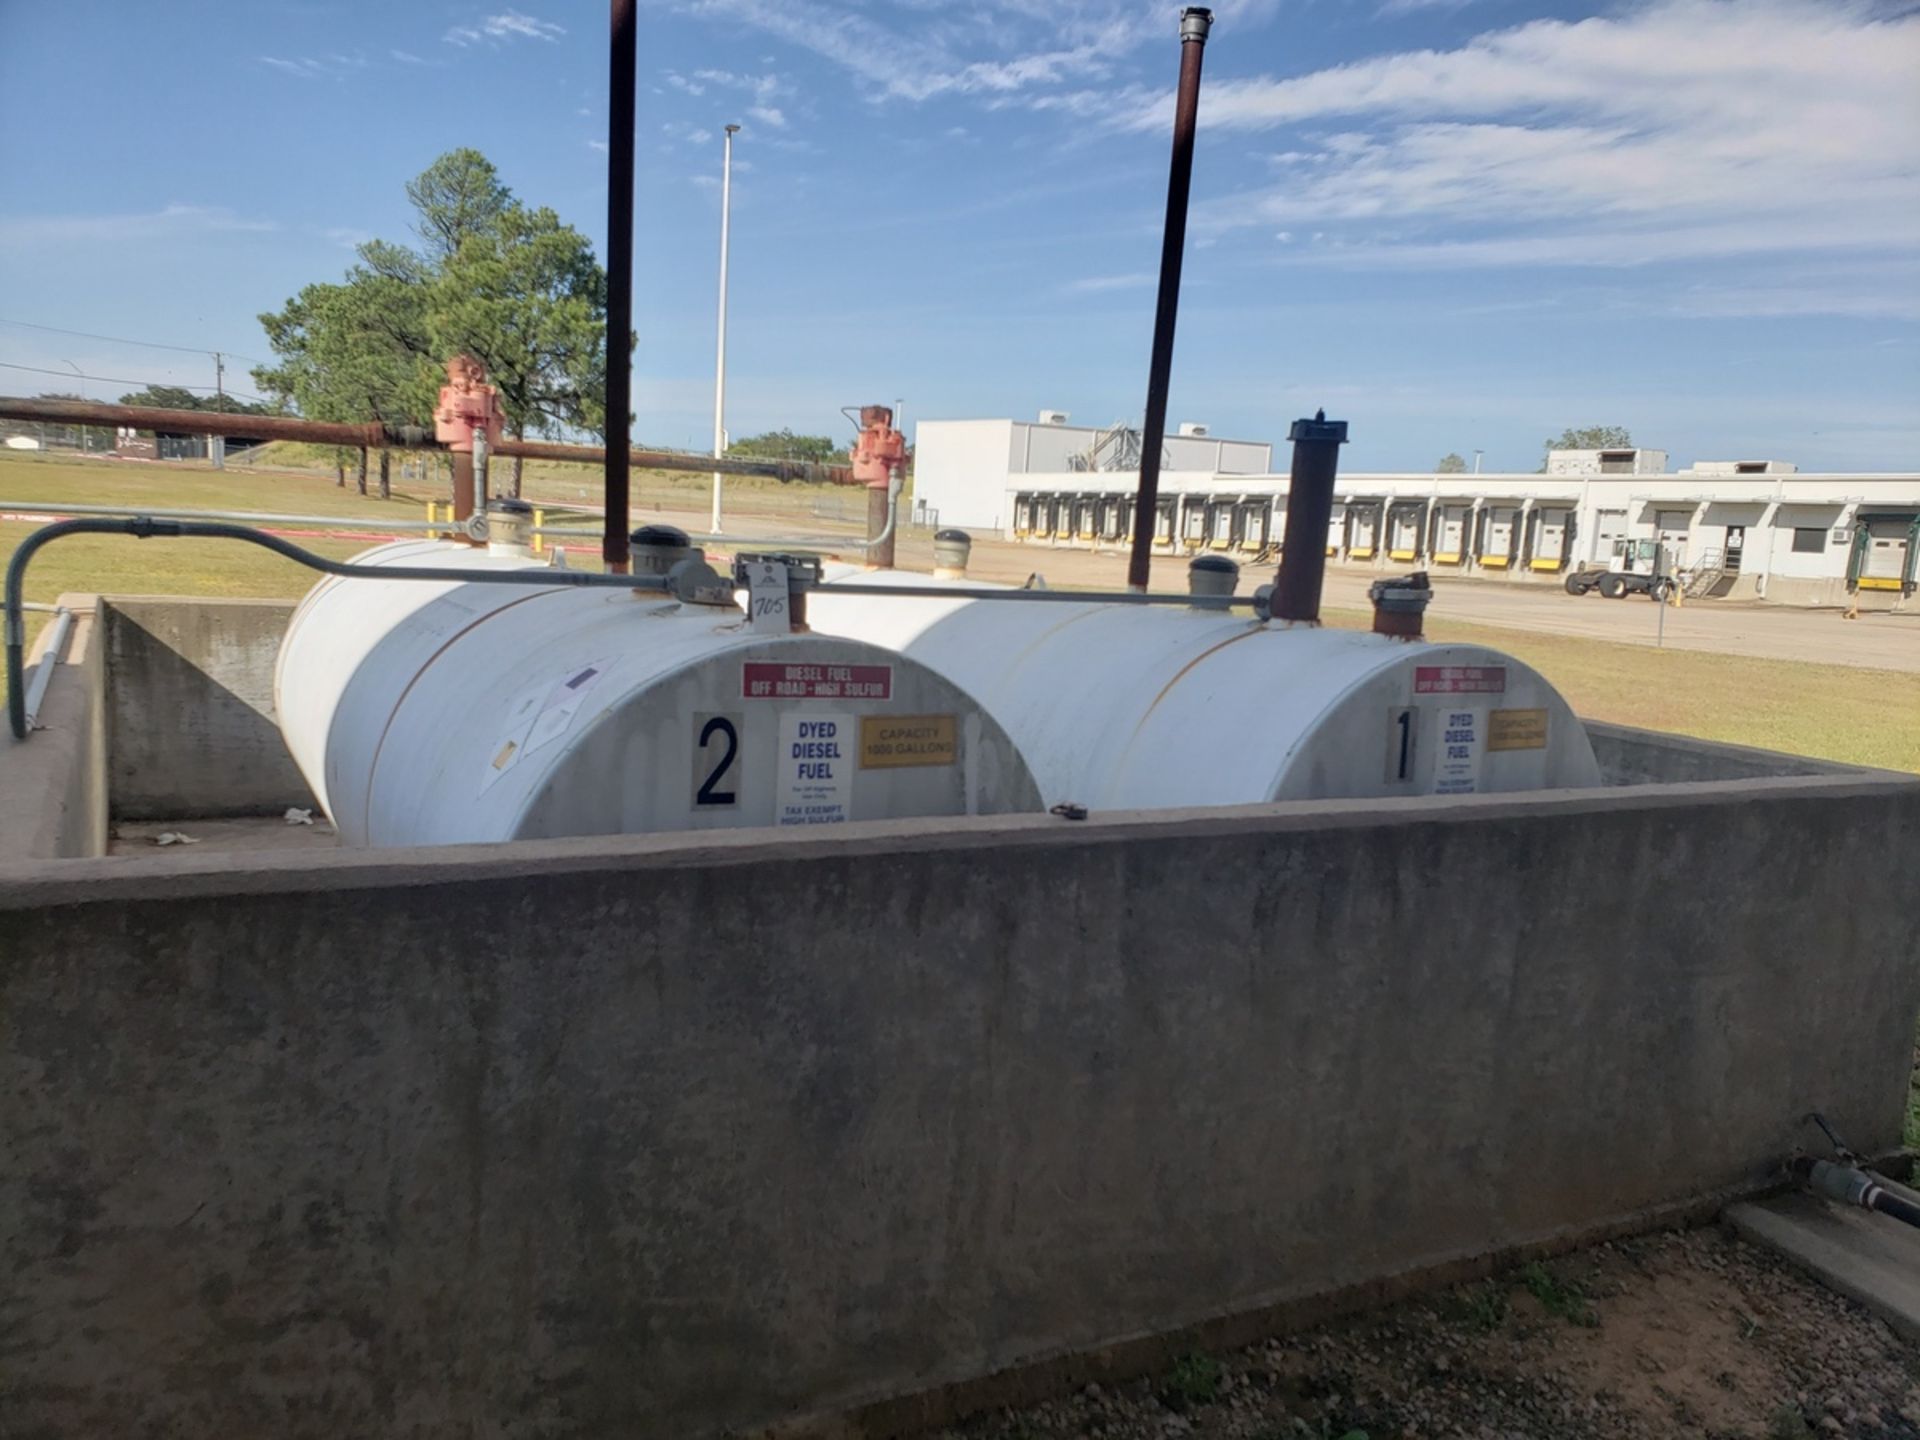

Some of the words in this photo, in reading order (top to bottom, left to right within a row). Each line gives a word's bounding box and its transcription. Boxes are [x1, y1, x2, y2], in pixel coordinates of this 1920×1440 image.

[755, 596, 786, 616] 705
[785, 666, 823, 681] DIESEL
[827, 667, 853, 681] FUEL
[751, 681, 772, 695] OFF
[775, 681, 806, 696] ROAD
[815, 682, 840, 696] HIGH
[845, 683, 884, 697] SULFUR
[799, 721, 837, 738] DYED
[879, 728, 940, 740] CAPACITY
[792, 742, 841, 759] DIESEL
[895, 742, 953, 754] GALLONS
[1397, 711, 1411, 779] 1
[697, 716, 738, 805] 2
[798, 763, 833, 779] FUEL
[786, 806, 803, 815] TAX
[804, 804, 843, 815] EXEMPT
[808, 814, 845, 825] SULFUR
